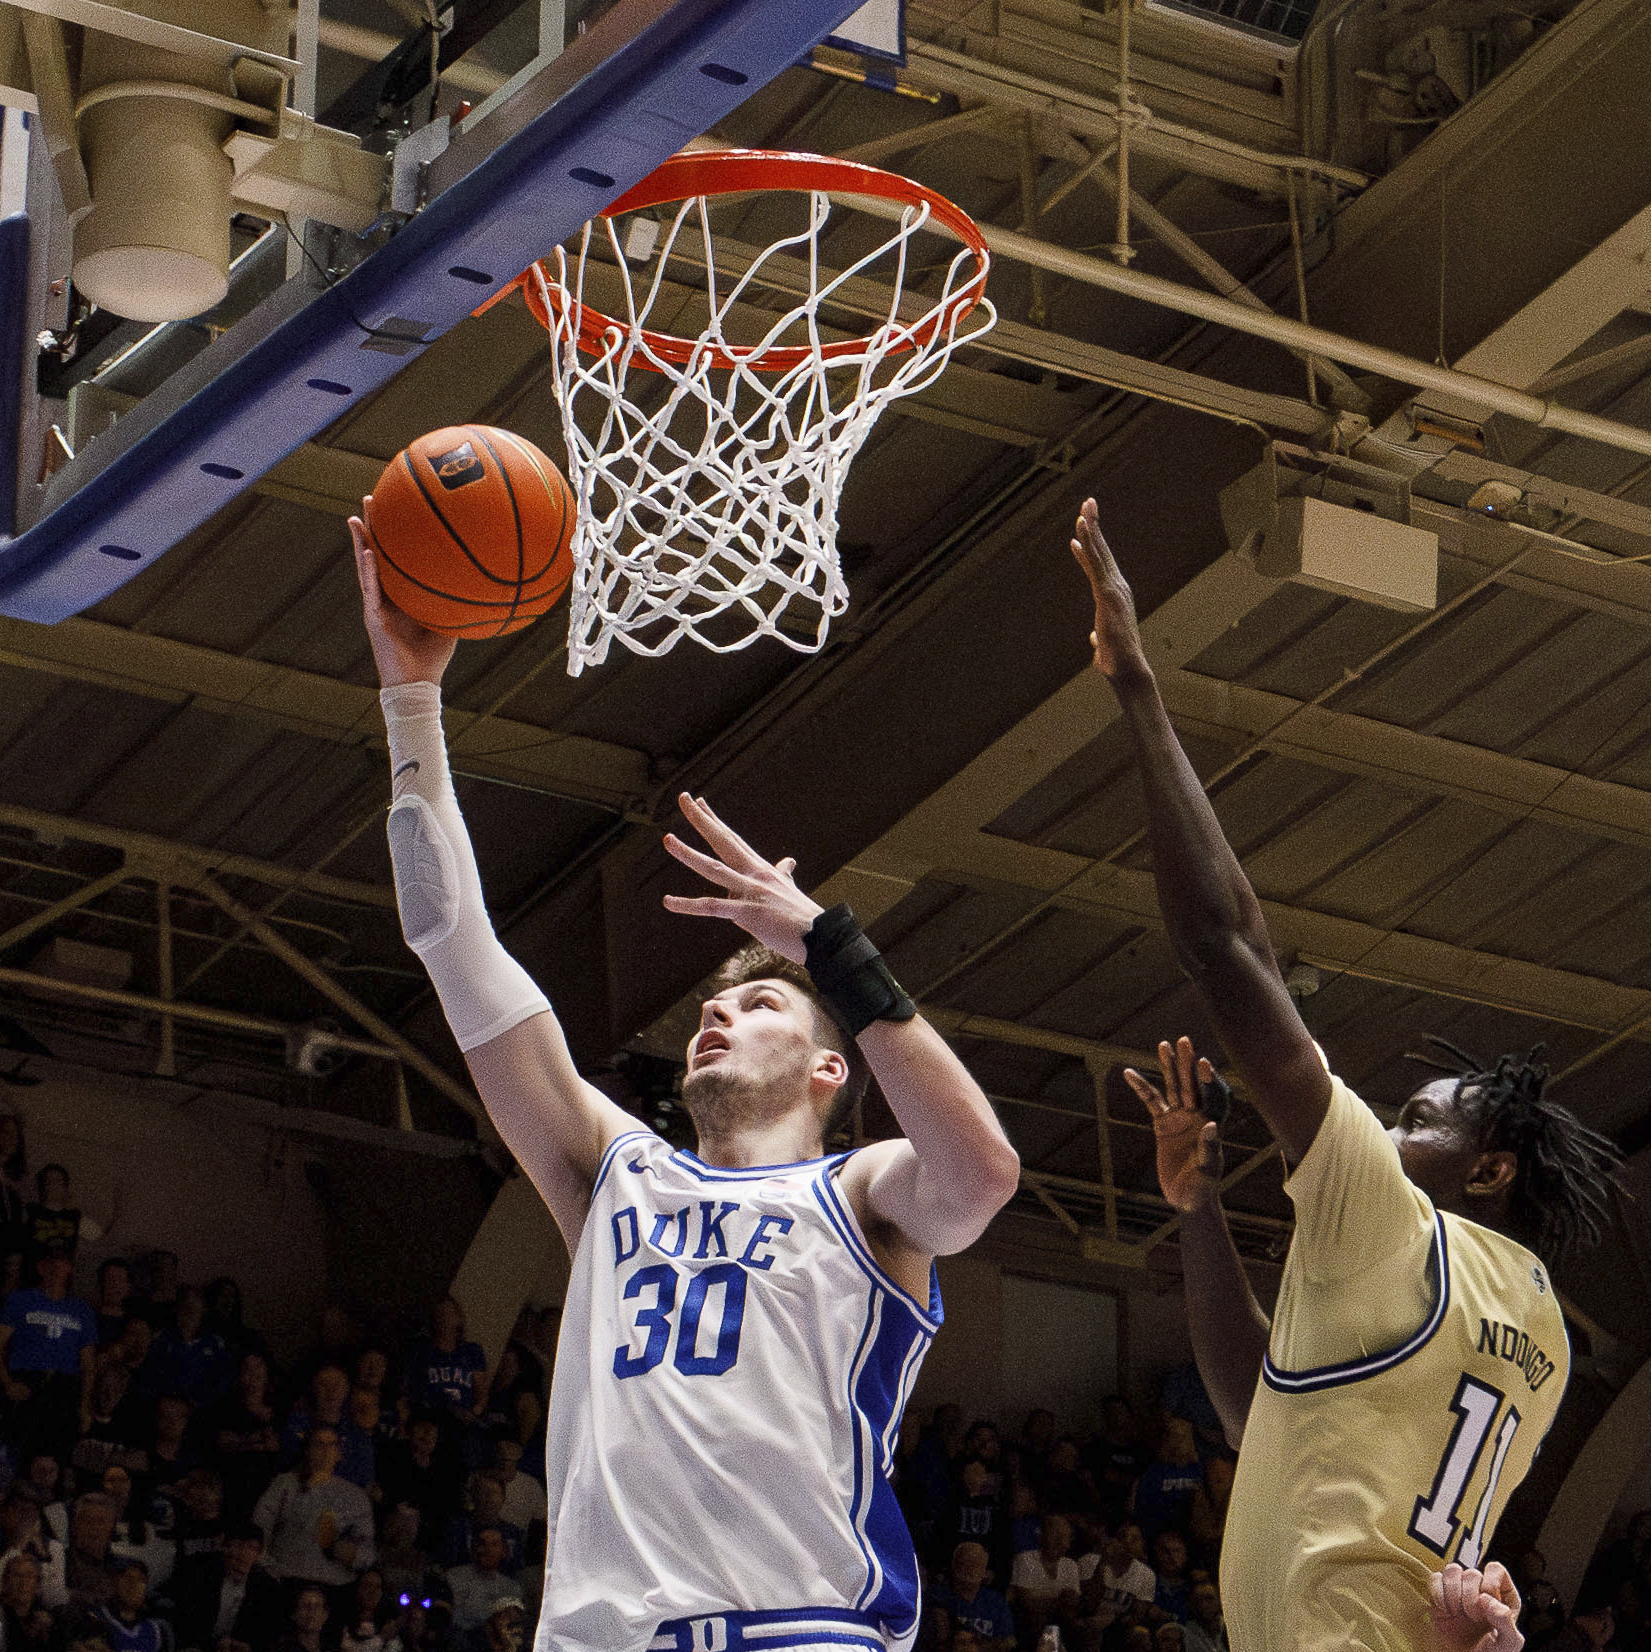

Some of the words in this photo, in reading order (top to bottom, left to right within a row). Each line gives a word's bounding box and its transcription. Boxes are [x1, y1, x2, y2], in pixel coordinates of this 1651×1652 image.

[611, 1200, 795, 1271] DUKE
[613, 1262, 748, 1380] 30
[1477, 1318, 1555, 1392] NDONGO
[1406, 1370, 1522, 1569] 11
